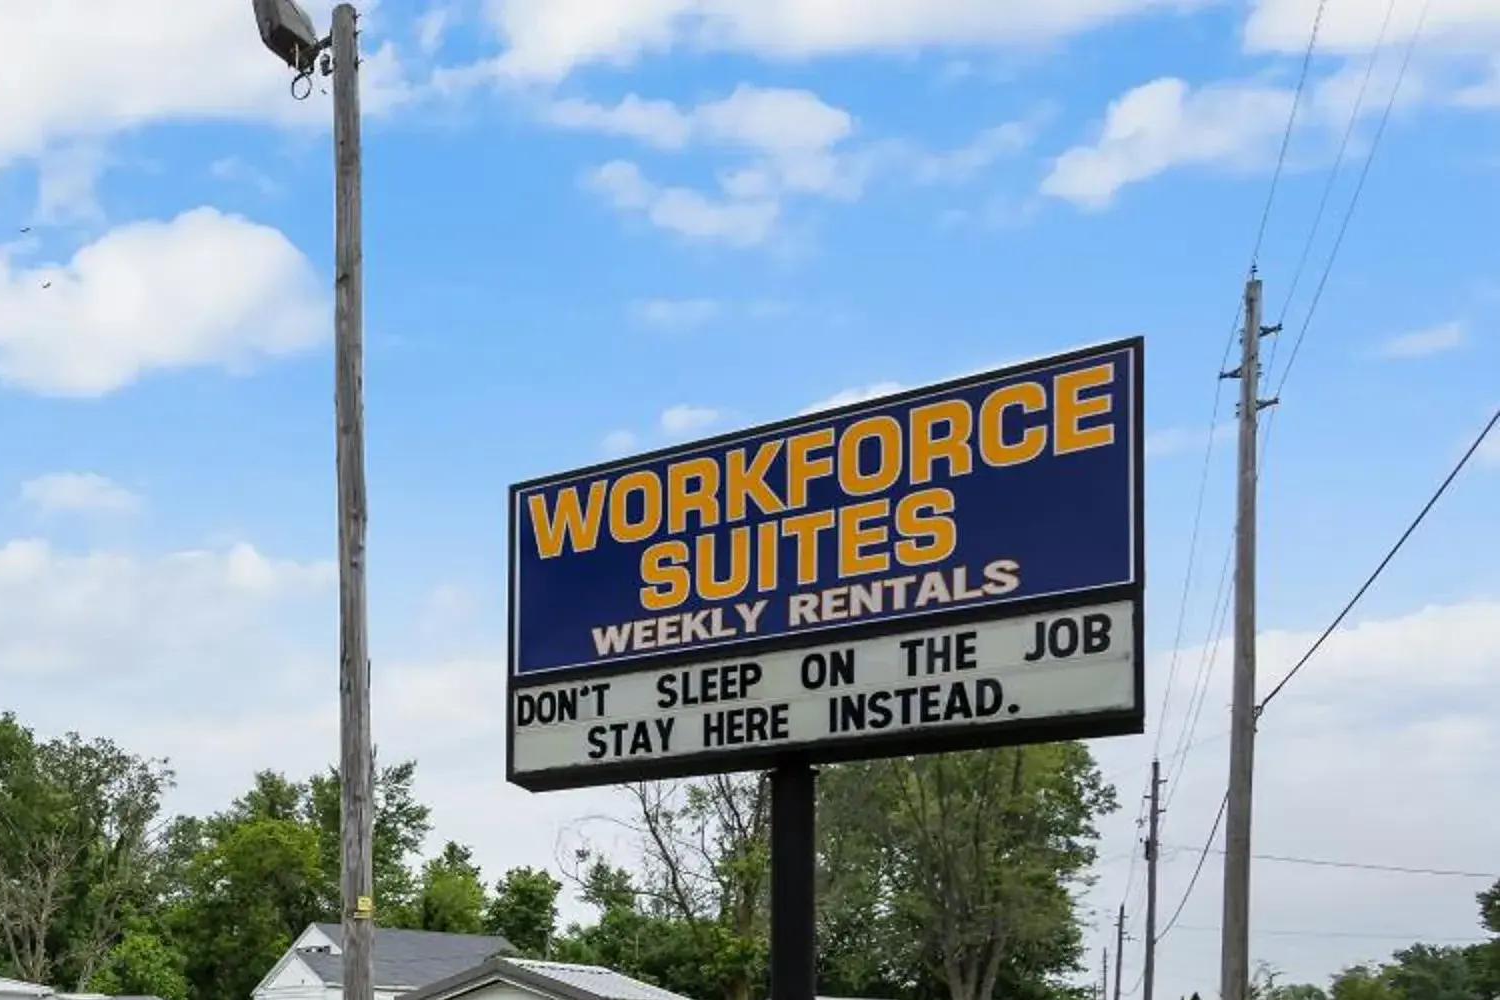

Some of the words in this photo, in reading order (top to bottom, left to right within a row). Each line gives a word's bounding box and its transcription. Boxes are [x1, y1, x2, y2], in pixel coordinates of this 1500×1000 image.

[528, 362, 1114, 560] WORKFORCE
[640, 488, 957, 610] SUITES
[592, 600, 768, 656] WEEKLY
[788, 559, 1021, 628] RENTALS
[516, 683, 610, 727] DON'T
[656, 662, 763, 709] SLEEP
[801, 648, 855, 690] ON
[900, 631, 977, 677] THE
[1024, 613, 1112, 662] JOB
[587, 717, 675, 760] STAY
[703, 703, 789, 748] HERE
[828, 677, 1021, 734] INSTEAD.
